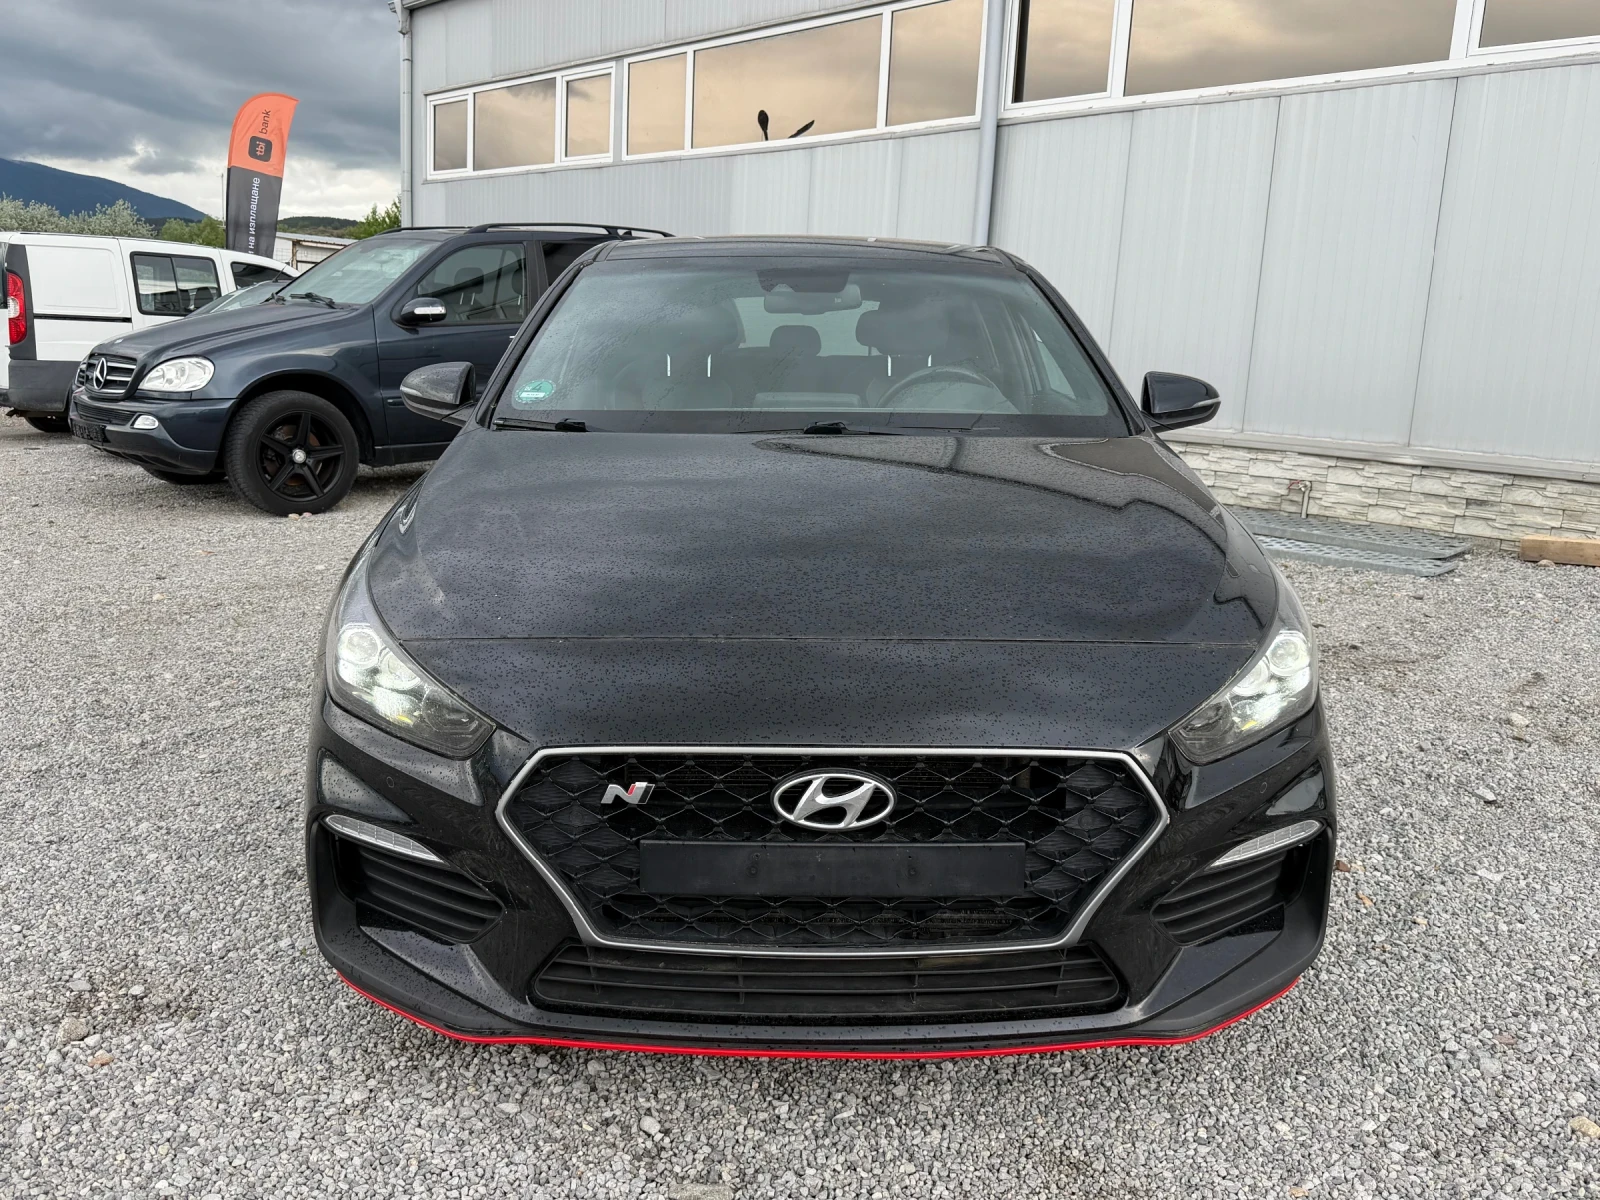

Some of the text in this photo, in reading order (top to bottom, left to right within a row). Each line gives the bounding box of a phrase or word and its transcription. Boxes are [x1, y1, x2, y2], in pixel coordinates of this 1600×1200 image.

[256, 109, 271, 156] tbi bank
[249, 177, 260, 235] изплащане
[248, 236, 255, 249] на
